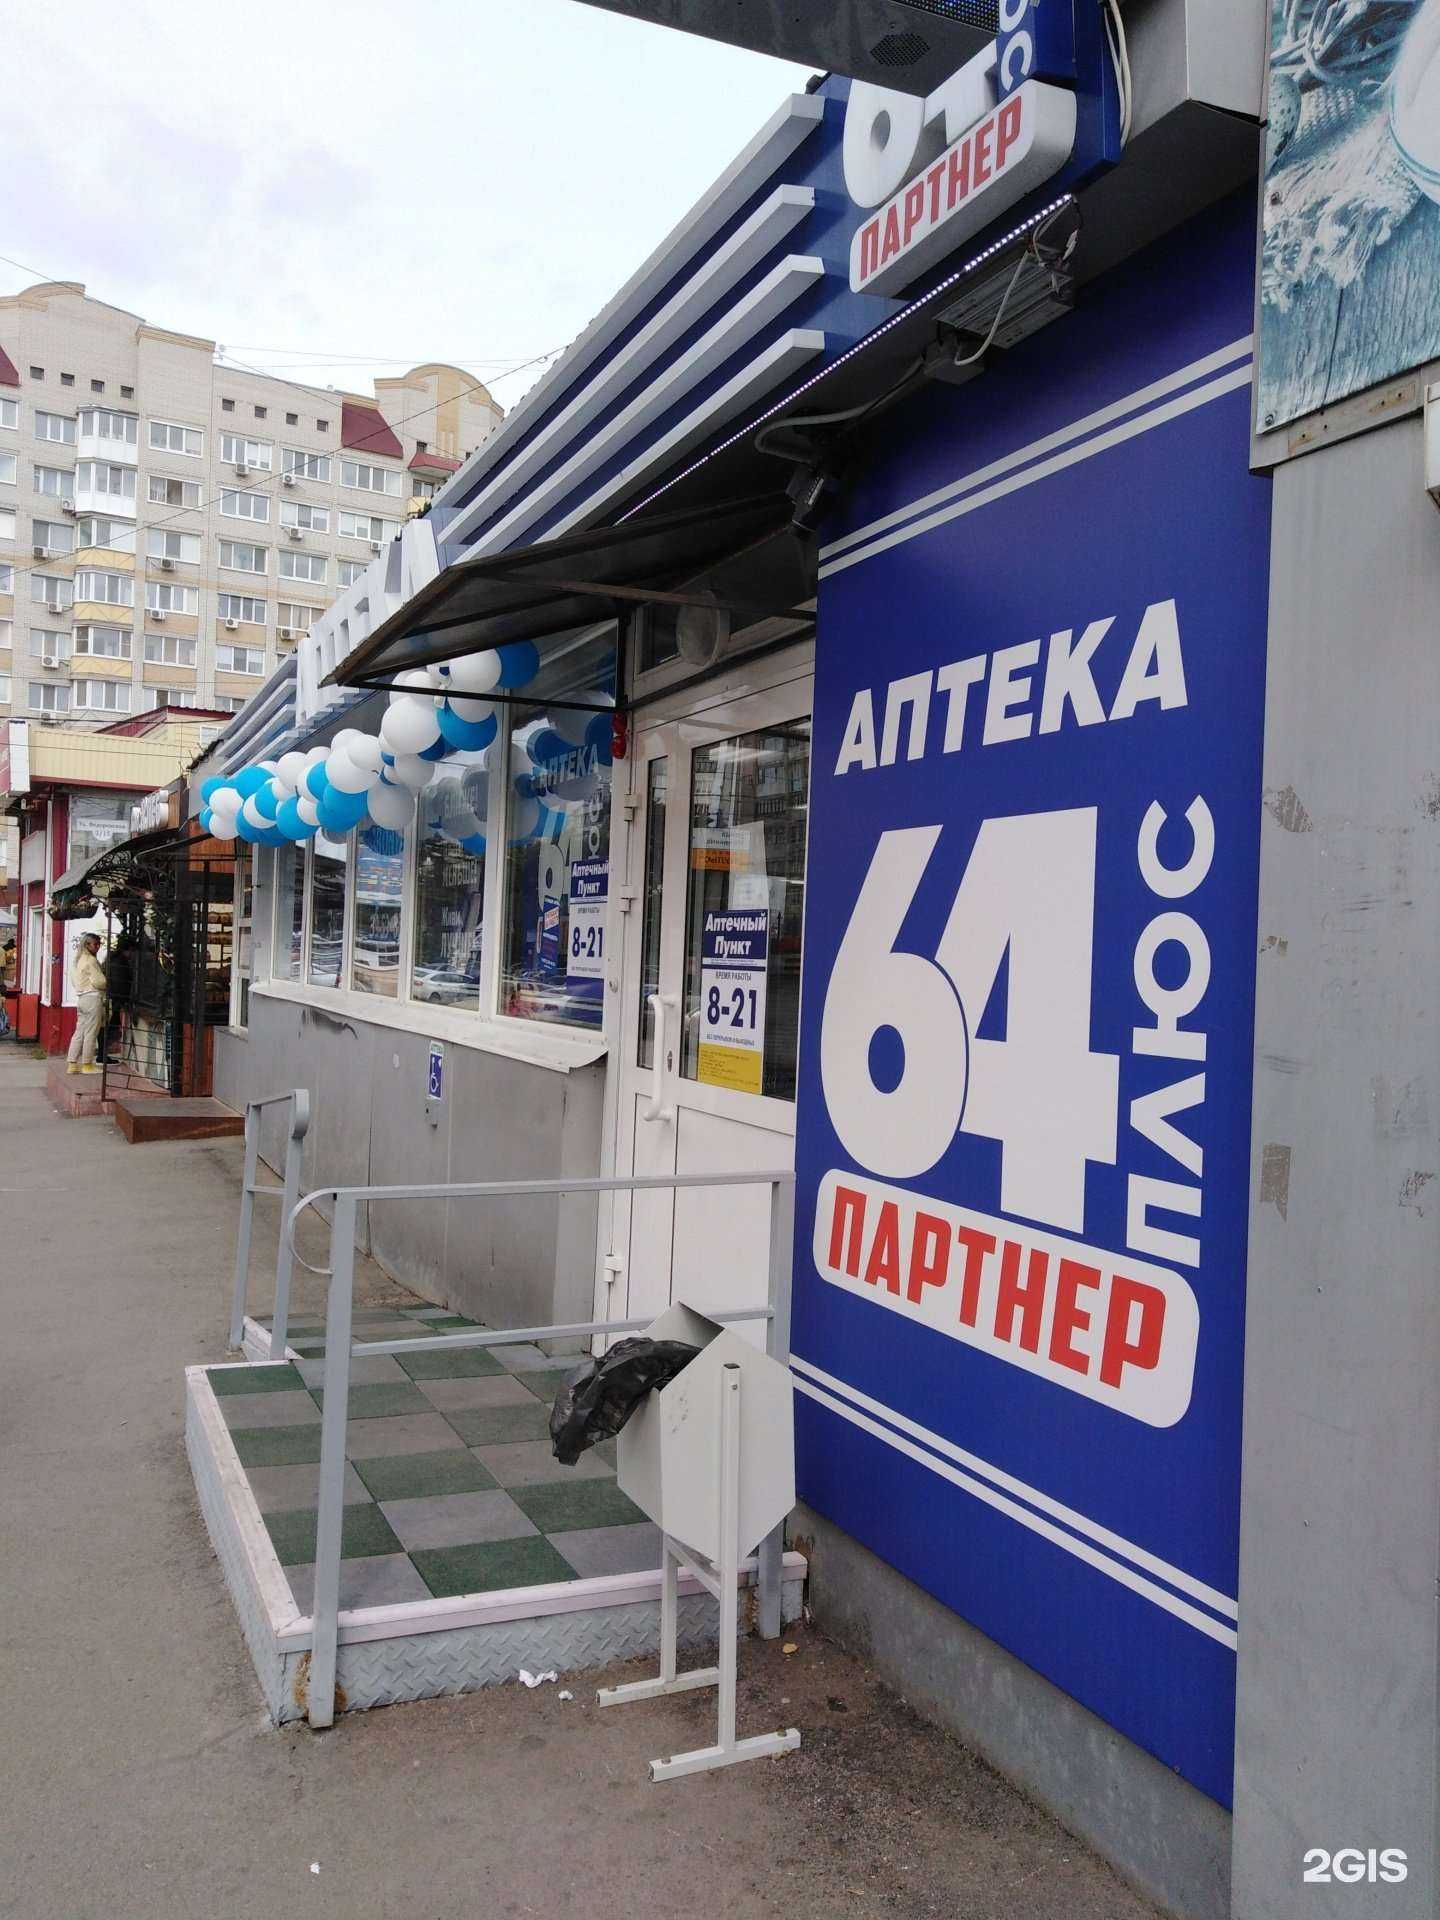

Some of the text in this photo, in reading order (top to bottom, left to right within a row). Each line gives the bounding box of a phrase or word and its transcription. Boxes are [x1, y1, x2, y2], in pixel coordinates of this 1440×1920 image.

[860, 95, 1022, 281] ПАРТНЕР
[834, 598, 1188, 776] АПТЕКА
[571, 861, 608, 878] Аптечный
[577, 880, 600, 898] Пункт
[571, 926, 604, 957] 8-21
[704, 911, 768, 932] Аптечный
[714, 935, 752, 959] Пункт
[707, 986, 757, 1030] 8-21
[821, 806, 1120, 1234] 64
[1126, 794, 1215, 1268] ПЛЮС
[828, 1185, 1166, 1389] ПАРТНЕР
